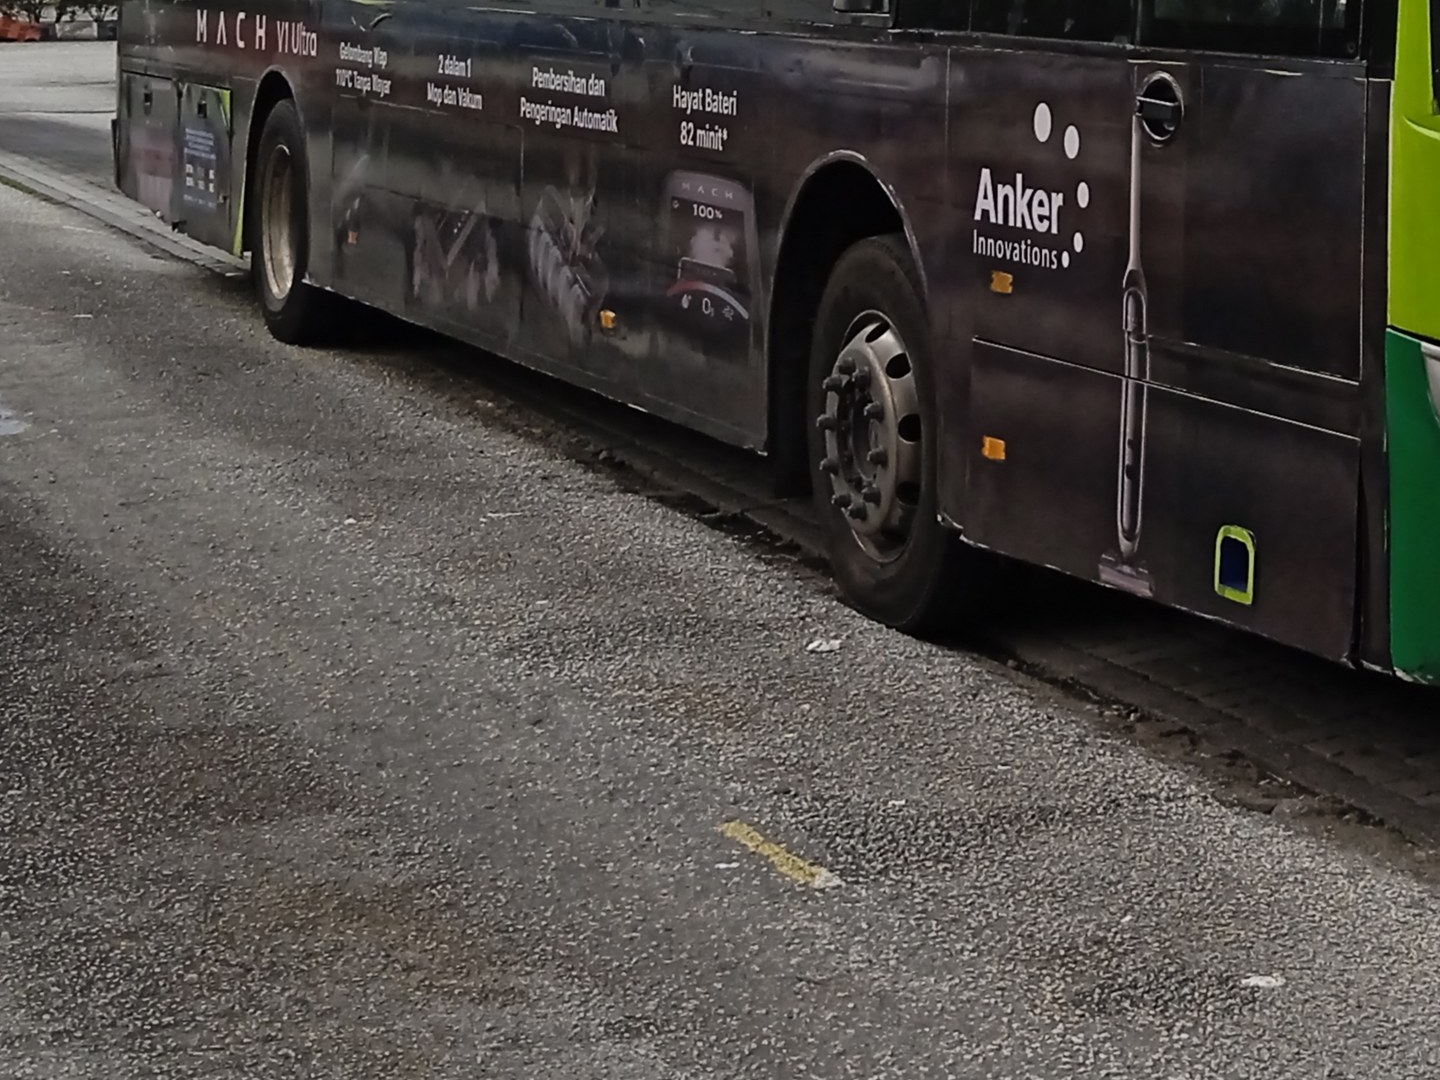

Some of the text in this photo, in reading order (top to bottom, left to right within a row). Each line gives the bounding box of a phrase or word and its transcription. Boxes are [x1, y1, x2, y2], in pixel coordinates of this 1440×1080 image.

[276, 19, 289, 52] V1
[290, 21, 318, 58] Ultra
[437, 54, 472, 78] 2 dalam 1
[532, 66, 605, 97] Pembersihan dan
[426, 81, 483, 110] Mop dan Vakum
[672, 85, 738, 116] Hayat Bateri
[520, 97, 618, 133] Pengeringan Automatik
[680, 120, 694, 146] 82
[692, 204, 723, 220] 100%
[973, 167, 1064, 235] Anker
[973, 229, 1058, 270] Innovations
